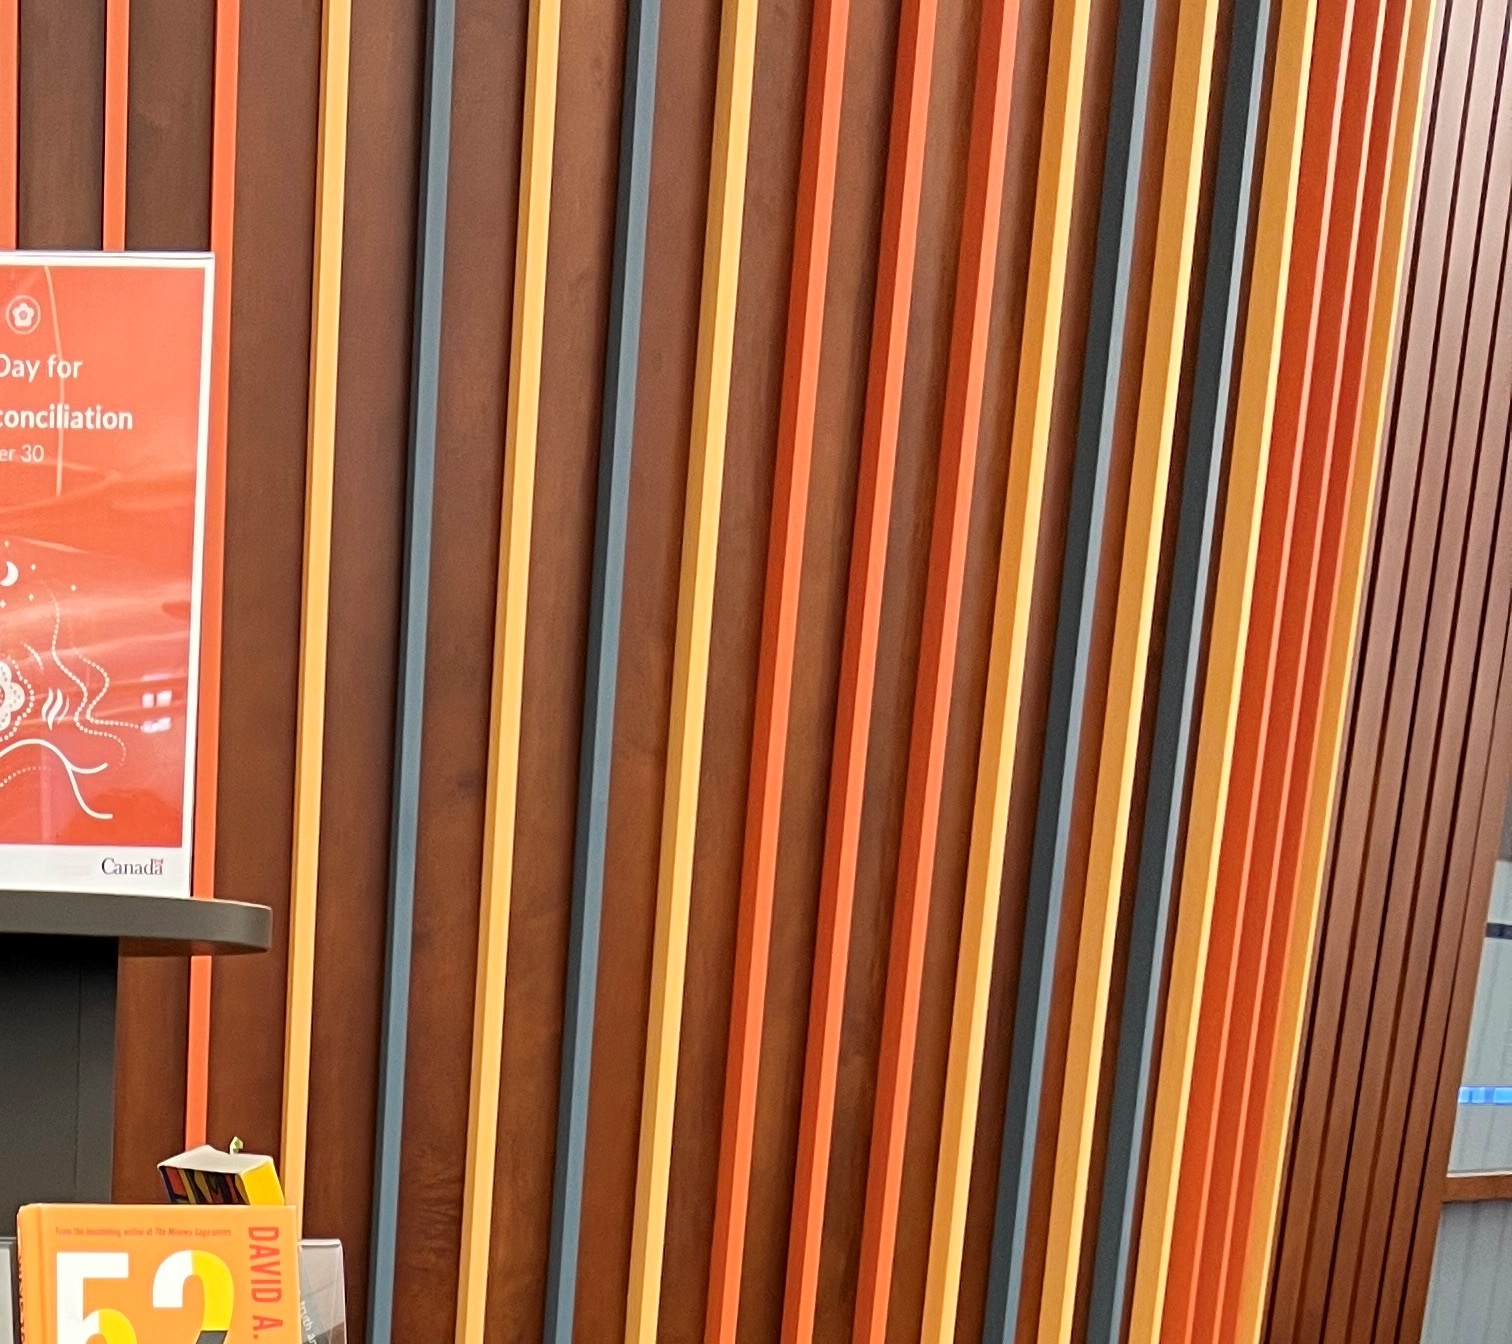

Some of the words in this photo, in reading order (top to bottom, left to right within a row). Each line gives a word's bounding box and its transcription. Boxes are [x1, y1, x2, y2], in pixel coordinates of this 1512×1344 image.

[47, 354, 83, 379] for
[21, 445, 45, 463] 30
[101, 857, 164, 876] Canada
[248, 1226, 283, 1303] DAVID
[252, 1315, 284, 1340] A.
